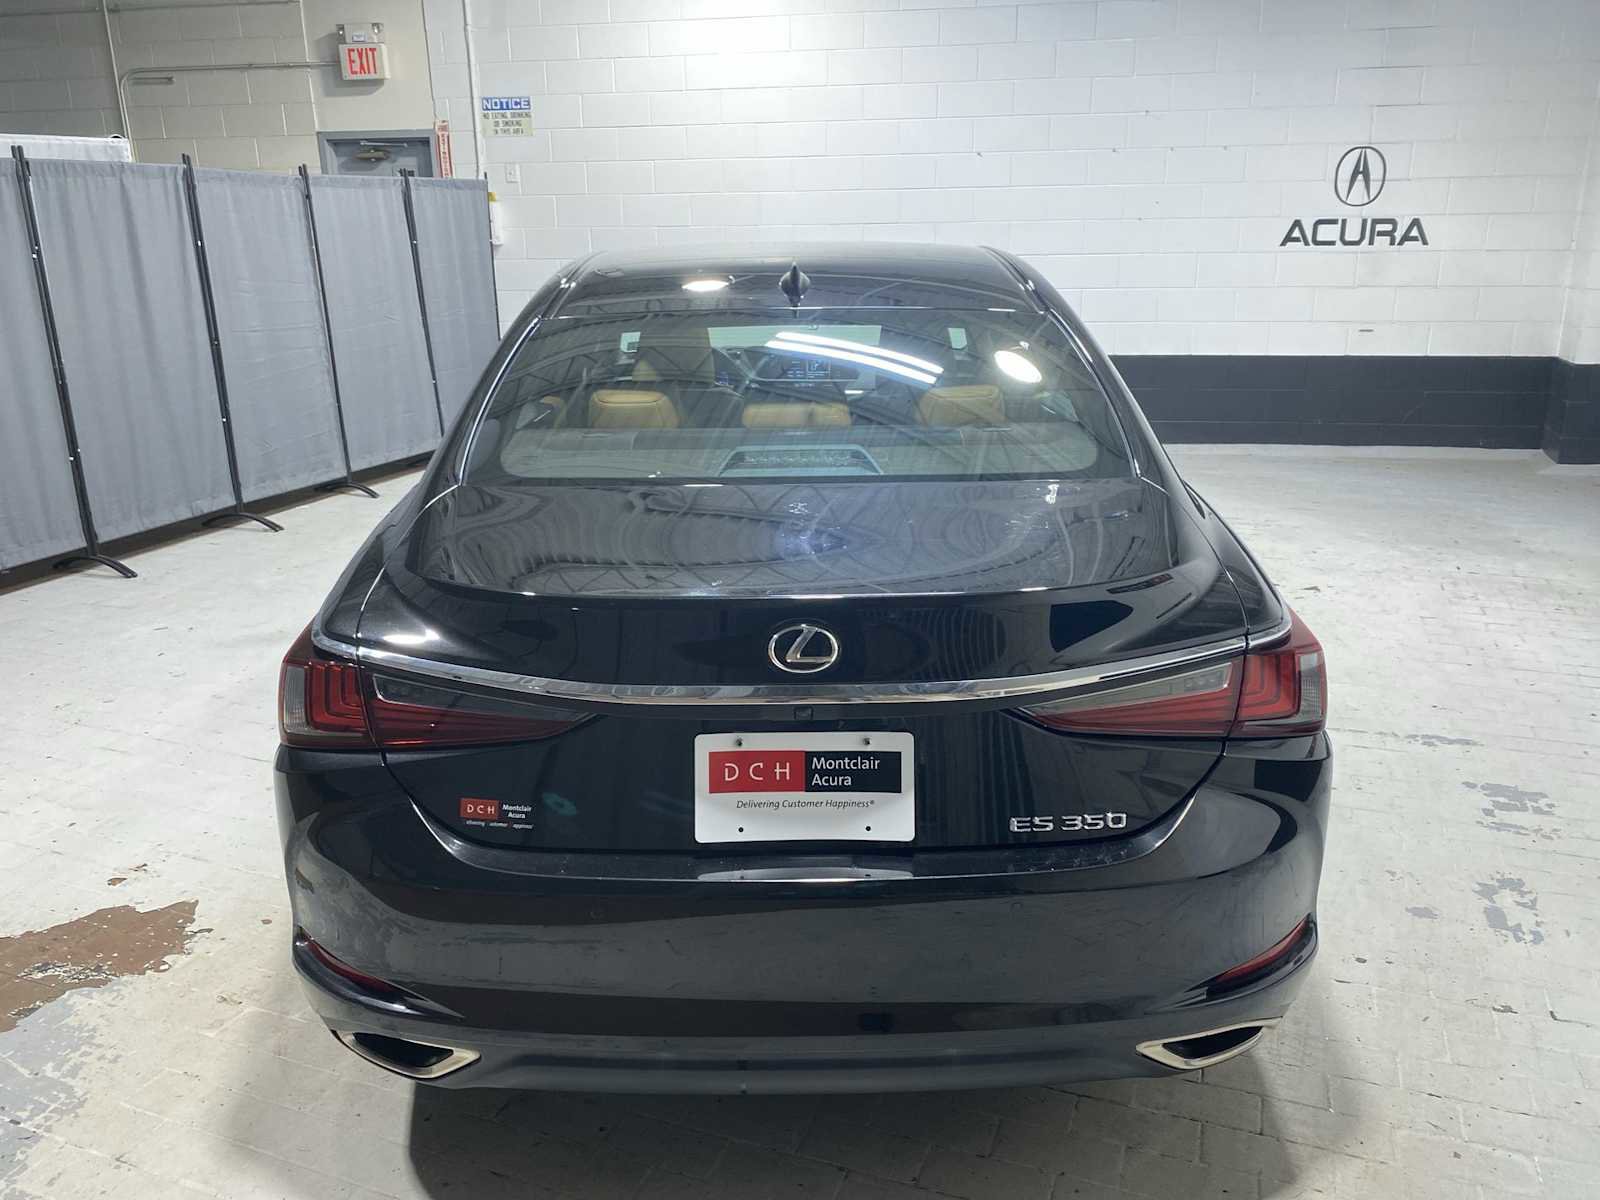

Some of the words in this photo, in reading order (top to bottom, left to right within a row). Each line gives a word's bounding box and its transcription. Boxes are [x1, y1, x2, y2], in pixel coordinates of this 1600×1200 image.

[347, 47, 377, 75] EXIT
[483, 98, 530, 110] NOTICE
[1280, 218, 1429, 247] ACURA
[811, 757, 881, 770] Montclair
[811, 773, 852, 787] Acura
[502, 804, 532, 812] Montclair
[736, 800, 780, 810] Delivering
[781, 800, 824, 808] Customer
[507, 811, 526, 819] Acura
[1009, 817, 1054, 832] ES
[1060, 812, 1127, 831] 350
